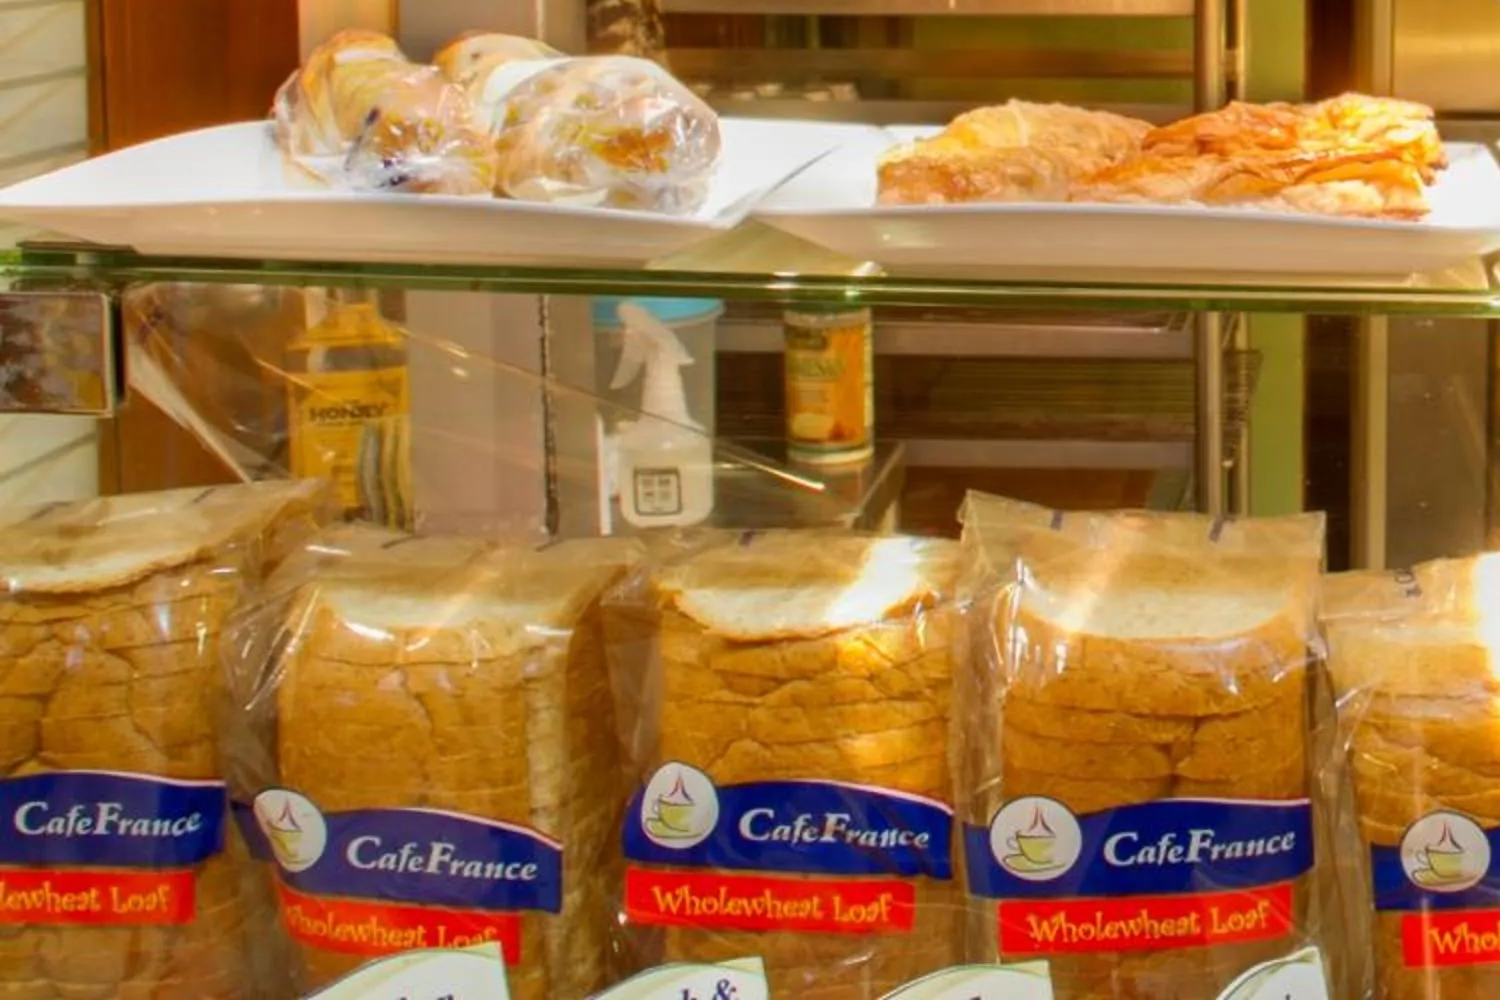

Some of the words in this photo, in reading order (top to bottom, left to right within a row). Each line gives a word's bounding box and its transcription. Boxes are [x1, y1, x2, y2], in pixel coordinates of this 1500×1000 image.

[14, 800, 203, 838] CafeFrance
[738, 808, 931, 848] CafeFrance
[346, 835, 538, 881] CafeFrance
[1102, 828, 1296, 867] CafeFrance
[109, 884, 172, 914] Loaf
[651, 884, 825, 922] Wholewheat
[832, 892, 893, 925] Loaf
[1024, 908, 1201, 945] Wholewheat
[1208, 899, 1271, 934] Loaf
